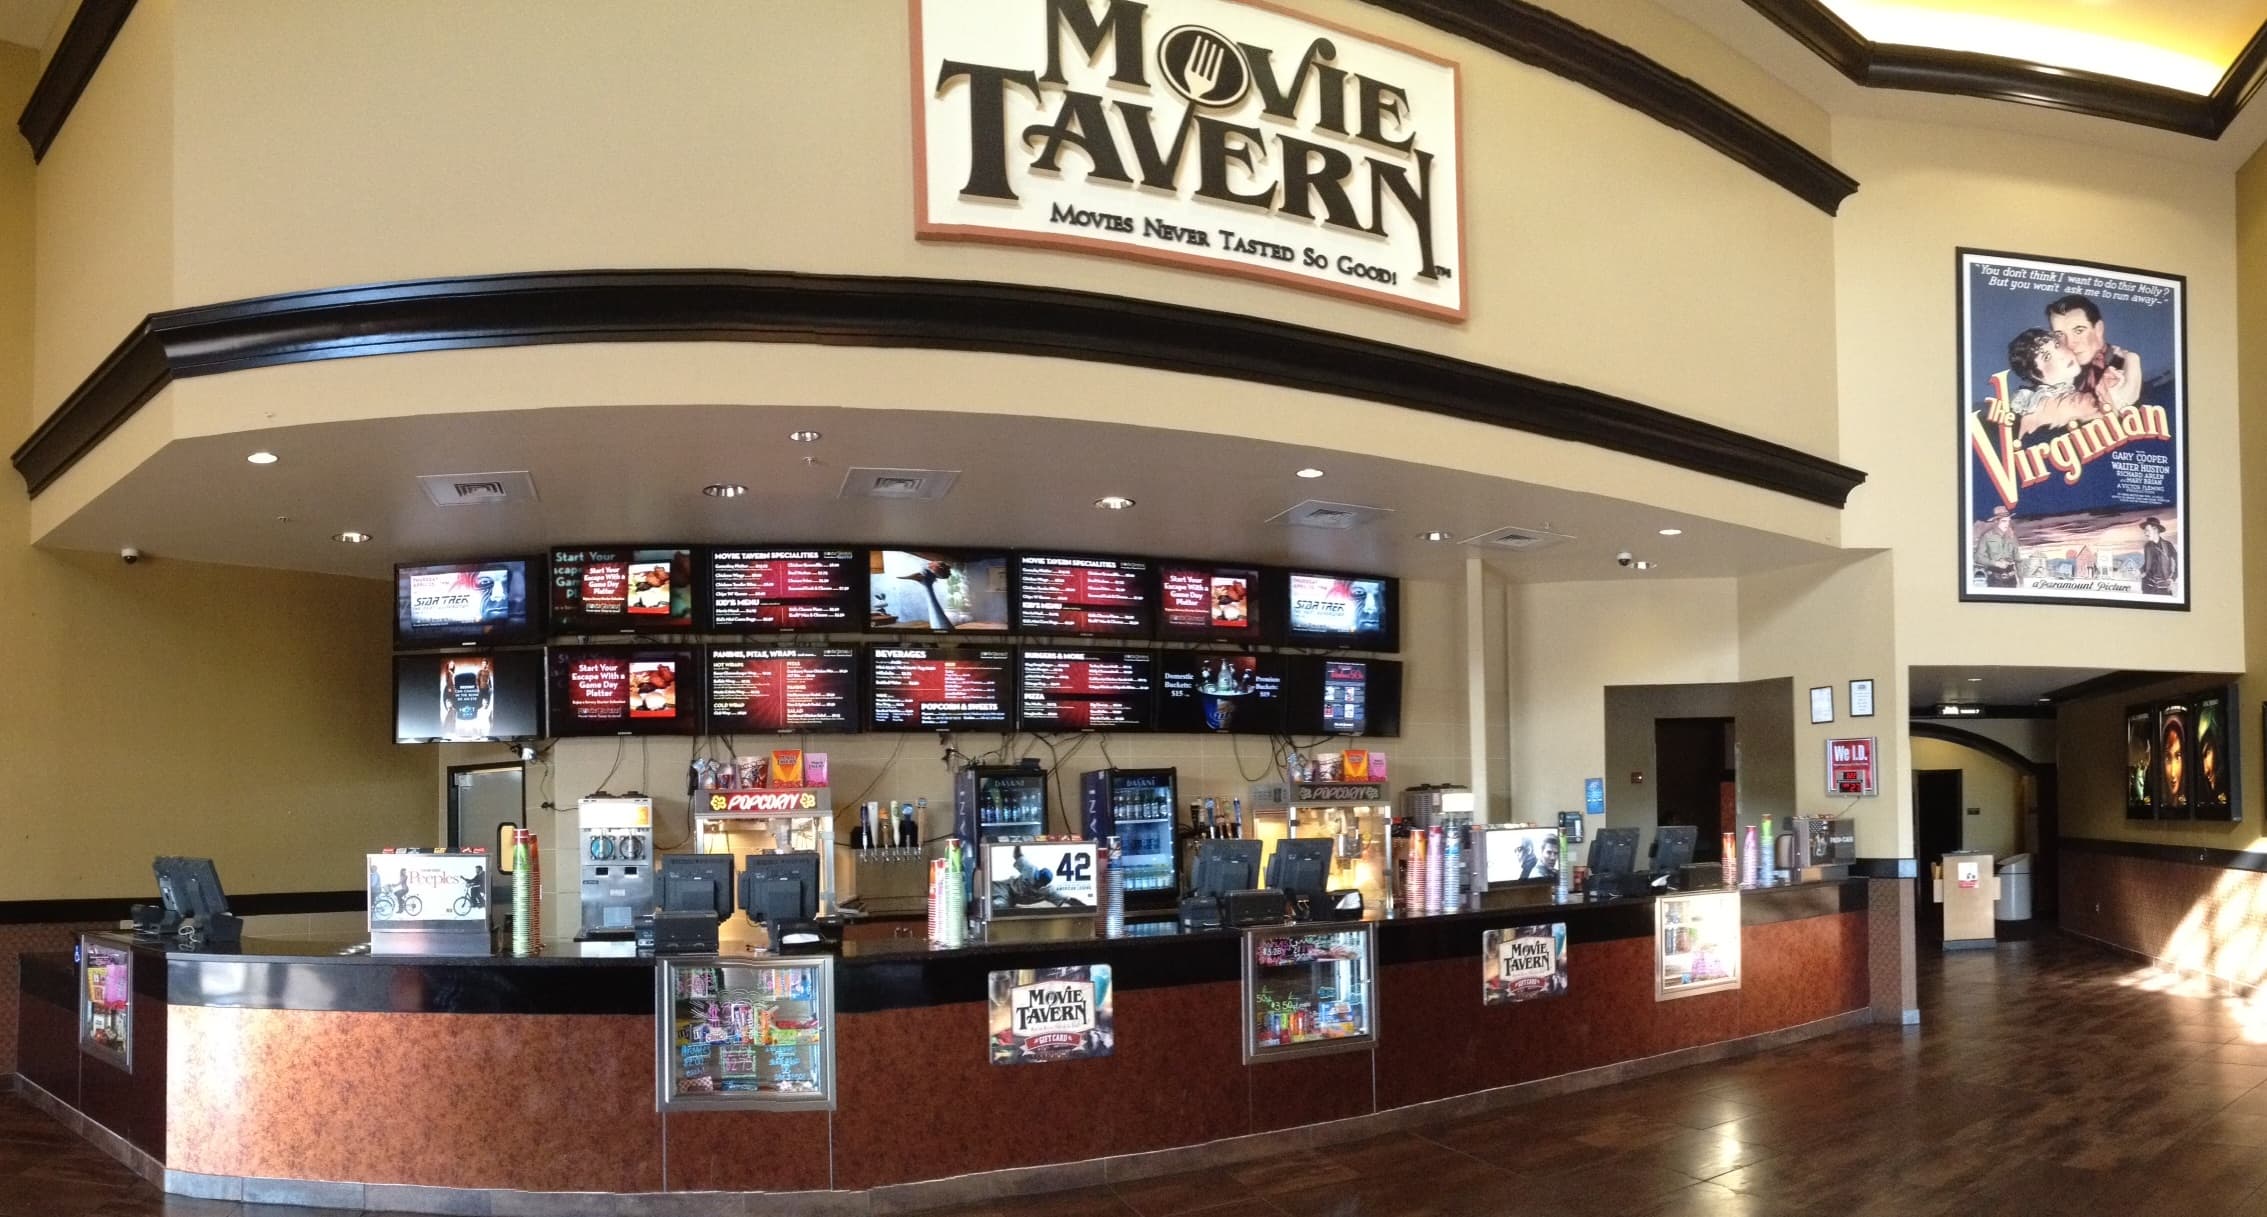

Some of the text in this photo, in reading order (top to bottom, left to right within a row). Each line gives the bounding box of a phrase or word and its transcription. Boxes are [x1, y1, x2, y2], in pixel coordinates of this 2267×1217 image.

[1040, 0, 1416, 152] MOVIE
[936, 59, 1434, 279] TAVERN
[1050, 202, 1134, 233] MOVIES
[1143, 218, 1210, 247] NEVER
[1219, 229, 1295, 262] TASTED
[1337, 255, 1397, 285] GOOD!
[2003, 267, 2027, 278] don't
[2029, 269, 2056, 282] think
[2067, 275, 2092, 286] want
[2093, 278, 2103, 287] to
[2104, 279, 2116, 289] do
[2117, 281, 2135, 292] this
[1988, 276, 2009, 287] But
[2010, 279, 2030, 290] you
[2033, 283, 2060, 292] won't
[2064, 285, 2083, 295] ask
[2084, 288, 2100, 297] me
[2102, 289, 2112, 298] to
[2112, 291, 2129, 300] run
[1985, 397, 2015, 427] The
[1972, 369, 2171, 510] Virginian
[2112, 451, 2168, 464] GARY COOPER
[2111, 461, 2170, 474] WALTER HUSTON
[555, 552, 616, 562] Start Your
[741, 552, 770, 560] TAVERN
[584, 574, 604, 582] Escape
[1187, 583, 1203, 591] With
[2038, 579, 2094, 590] Paramount
[2096, 581, 2132, 592] Picture
[415, 594, 470, 607] STAR TREK
[1175, 598, 1199, 606] Platter
[1190, 591, 1203, 600] Day
[1294, 600, 1345, 611] STAR TREK
[875, 650, 927, 658] BEVERAGES
[578, 664, 618, 672] Start Your
[571, 673, 599, 681] Escape
[600, 672, 619, 680] With
[579, 681, 618, 690] Game Day
[1164, 681, 1192, 689] Buckets:
[1833, 745, 1850, 761] We
[728, 792, 800, 810] POPCORN
[1056, 852, 1091, 881] 42
[408, 871, 459, 888] Peeples
[1511, 941, 1548, 959] MOVIE
[1504, 952, 1550, 976] TAVERN
[1028, 986, 1084, 1007] MOVIE
[1016, 1000, 1087, 1030] TAVERN
